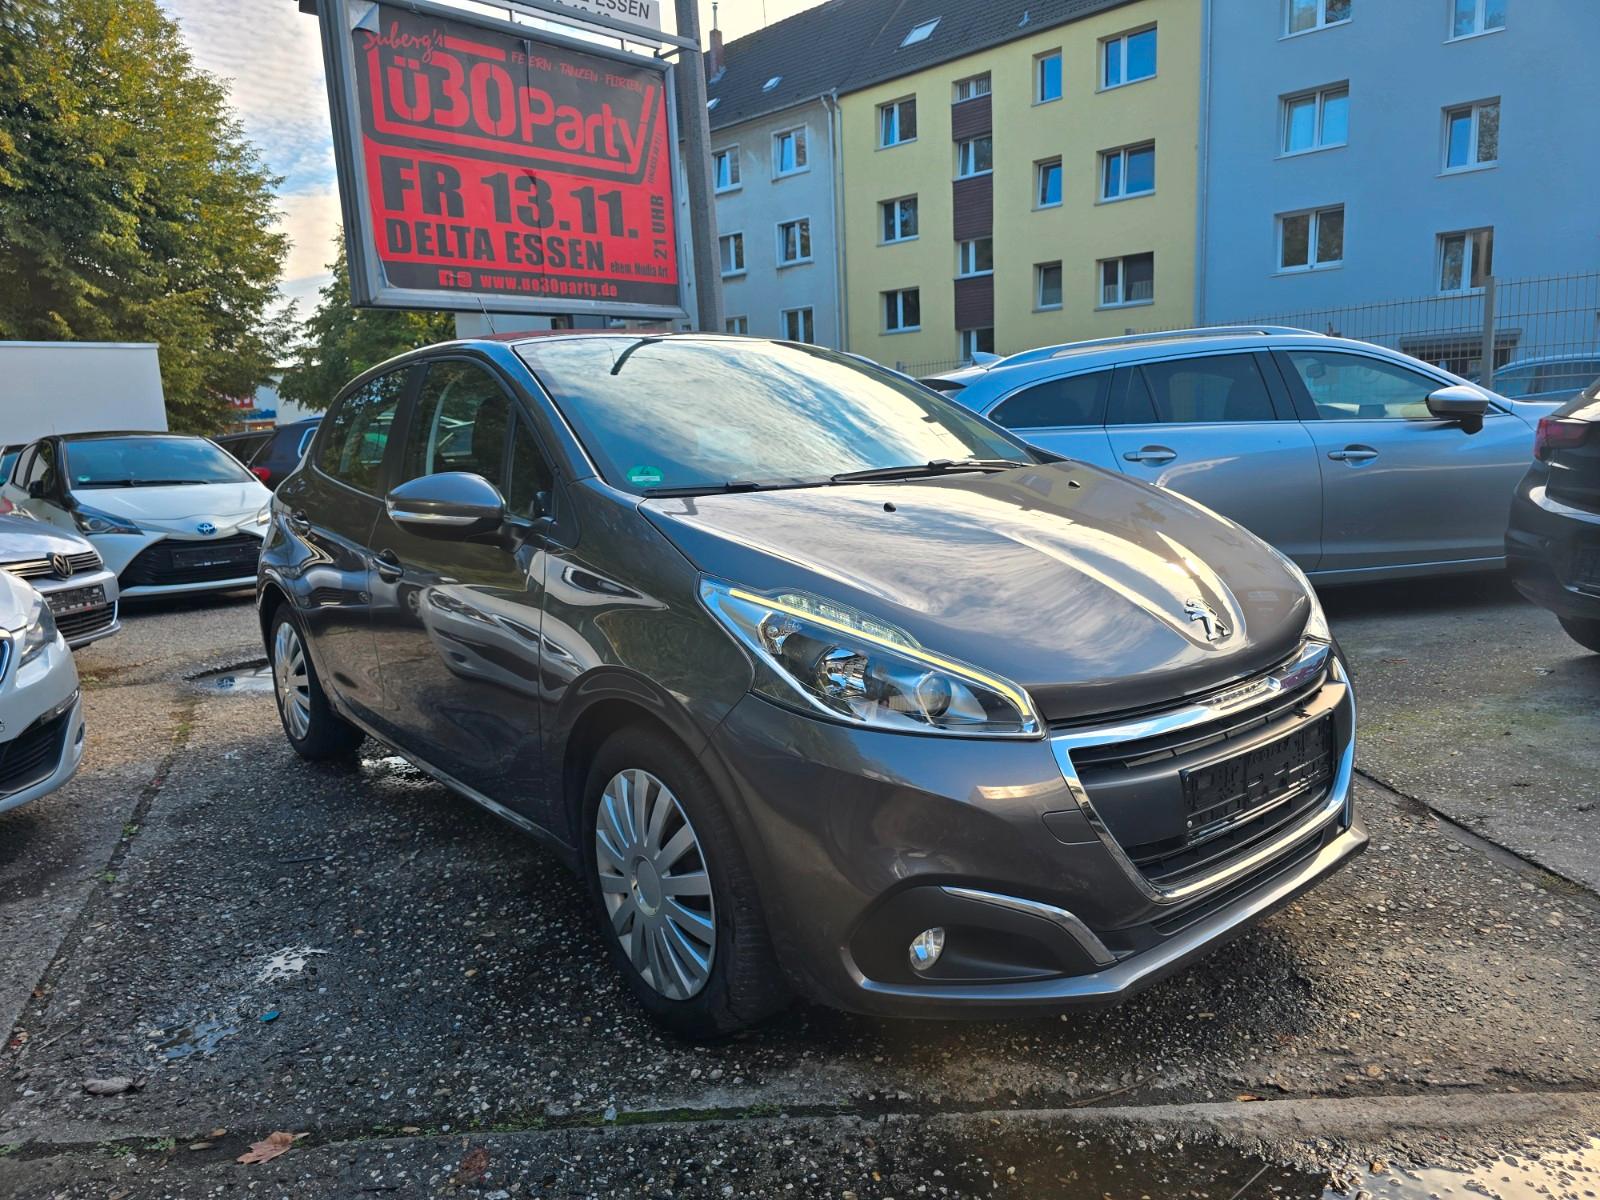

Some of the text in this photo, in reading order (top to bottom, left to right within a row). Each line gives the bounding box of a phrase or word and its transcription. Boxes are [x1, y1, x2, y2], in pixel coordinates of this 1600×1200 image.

[511, 51, 552, 71] FEERN
[518, 85, 655, 174] Party
[379, 154, 640, 240] FR 13.11.
[651, 194, 667, 235] UHR
[385, 217, 606, 272] DELTA ESSEN
[653, 238, 668, 260] 21
[479, 273, 619, 298] www.ue30party.de
